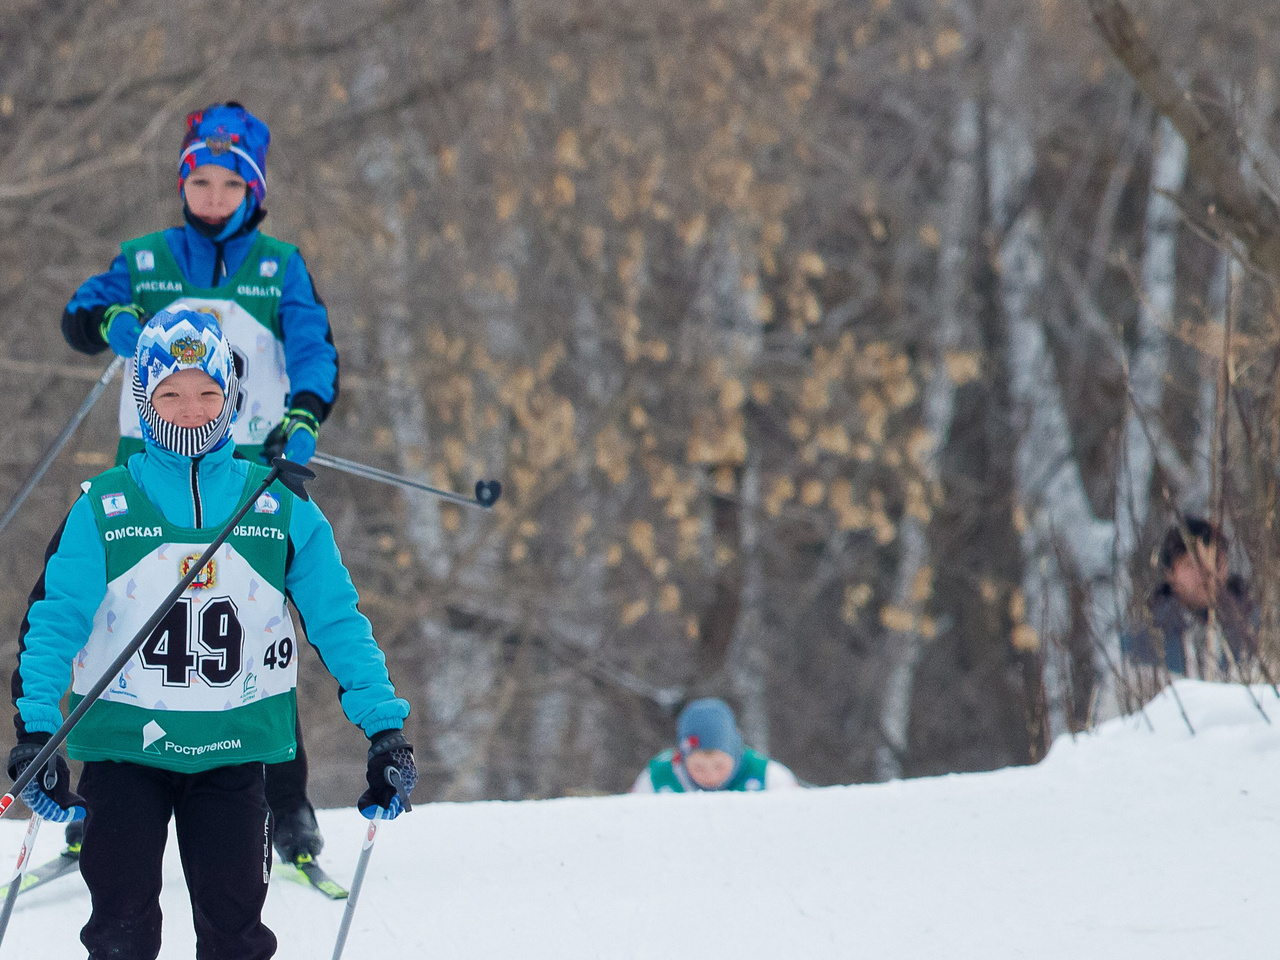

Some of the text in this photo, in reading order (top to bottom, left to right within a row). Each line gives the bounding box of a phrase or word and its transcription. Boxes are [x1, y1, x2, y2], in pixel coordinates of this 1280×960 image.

[105, 525, 285, 542] ОМСКАЯ ОБЛАСТЬ
[137, 595, 246, 688] 49
[263, 637, 293, 670] 49
[165, 739, 241, 756] Ростелеком
